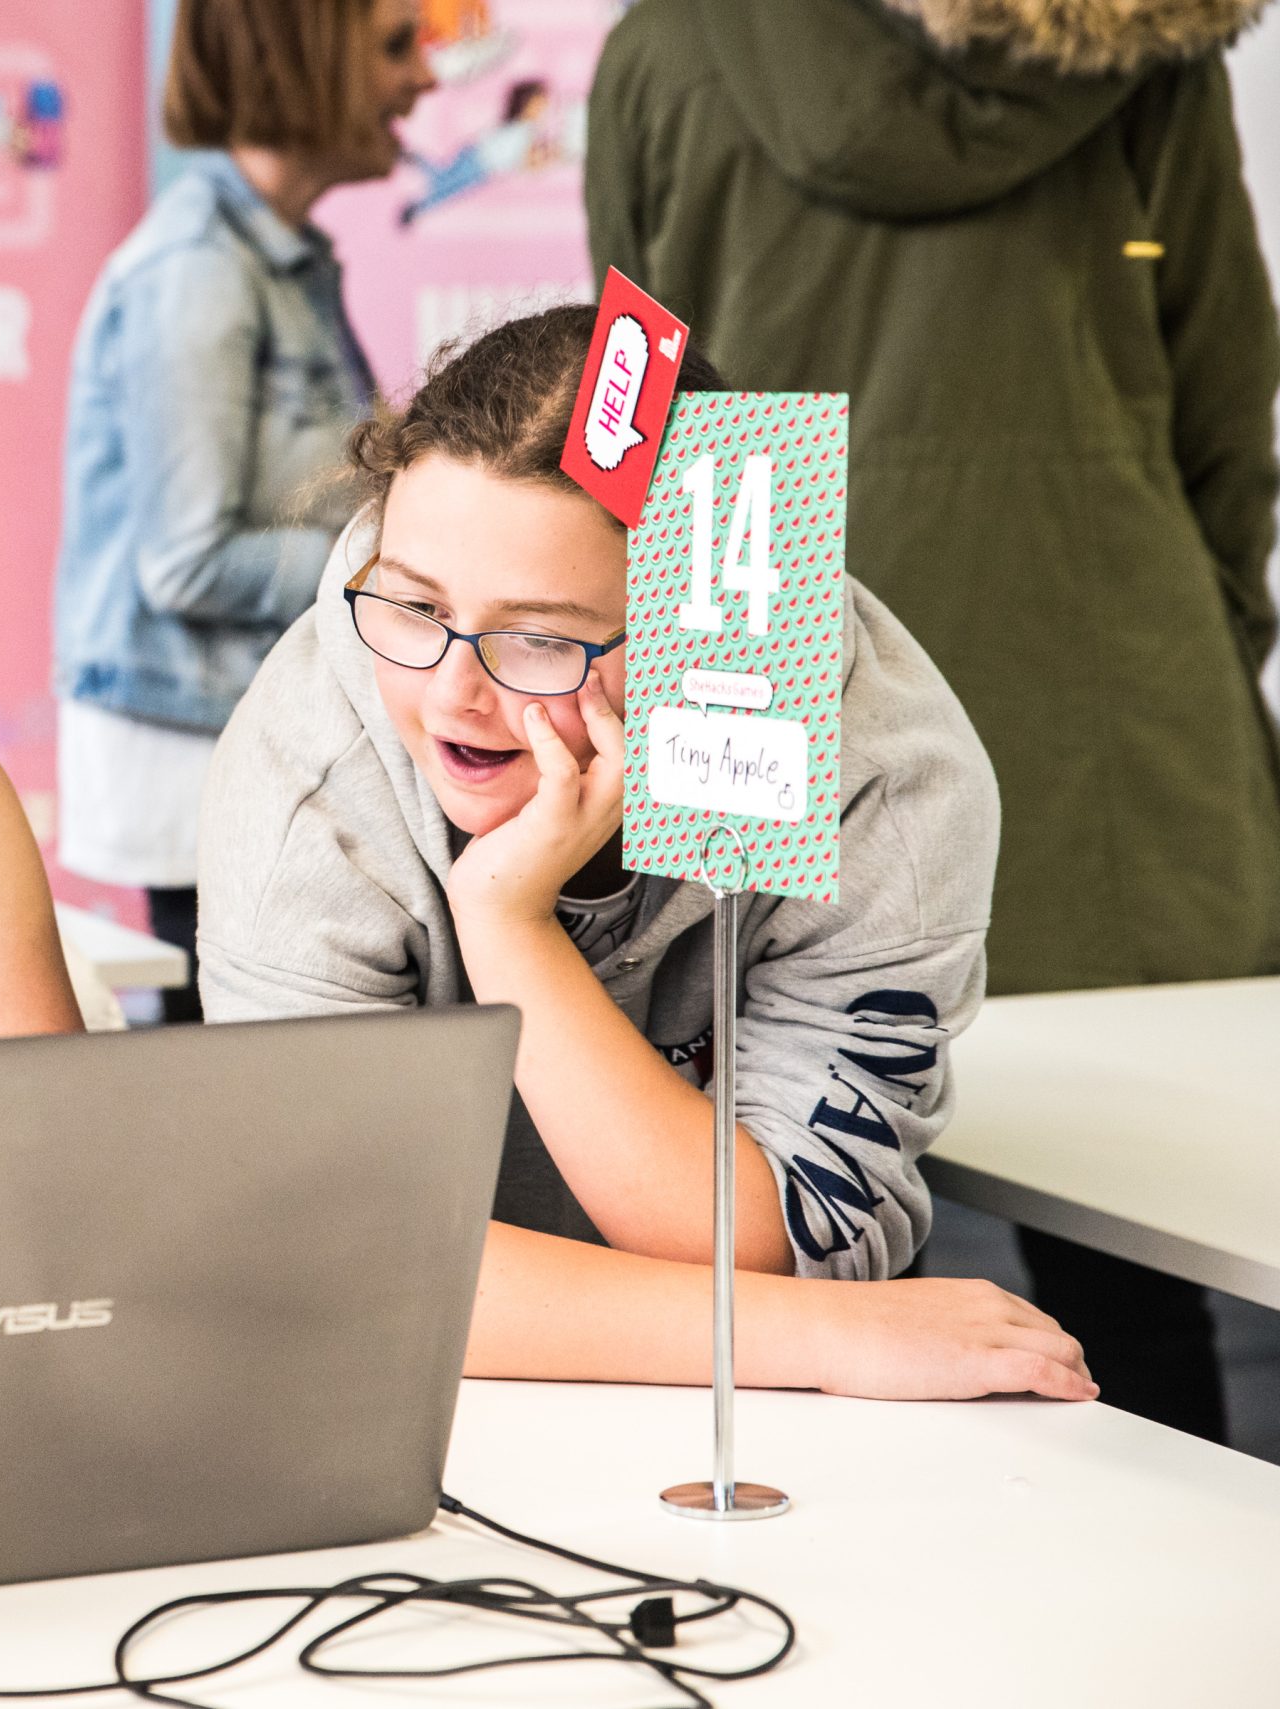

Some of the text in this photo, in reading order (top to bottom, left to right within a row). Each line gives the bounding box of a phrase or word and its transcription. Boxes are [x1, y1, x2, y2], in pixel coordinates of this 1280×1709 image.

[598, 349, 632, 436] HELP
[679, 453, 780, 637] 14
[666, 734, 779, 786] Tiny Apple
